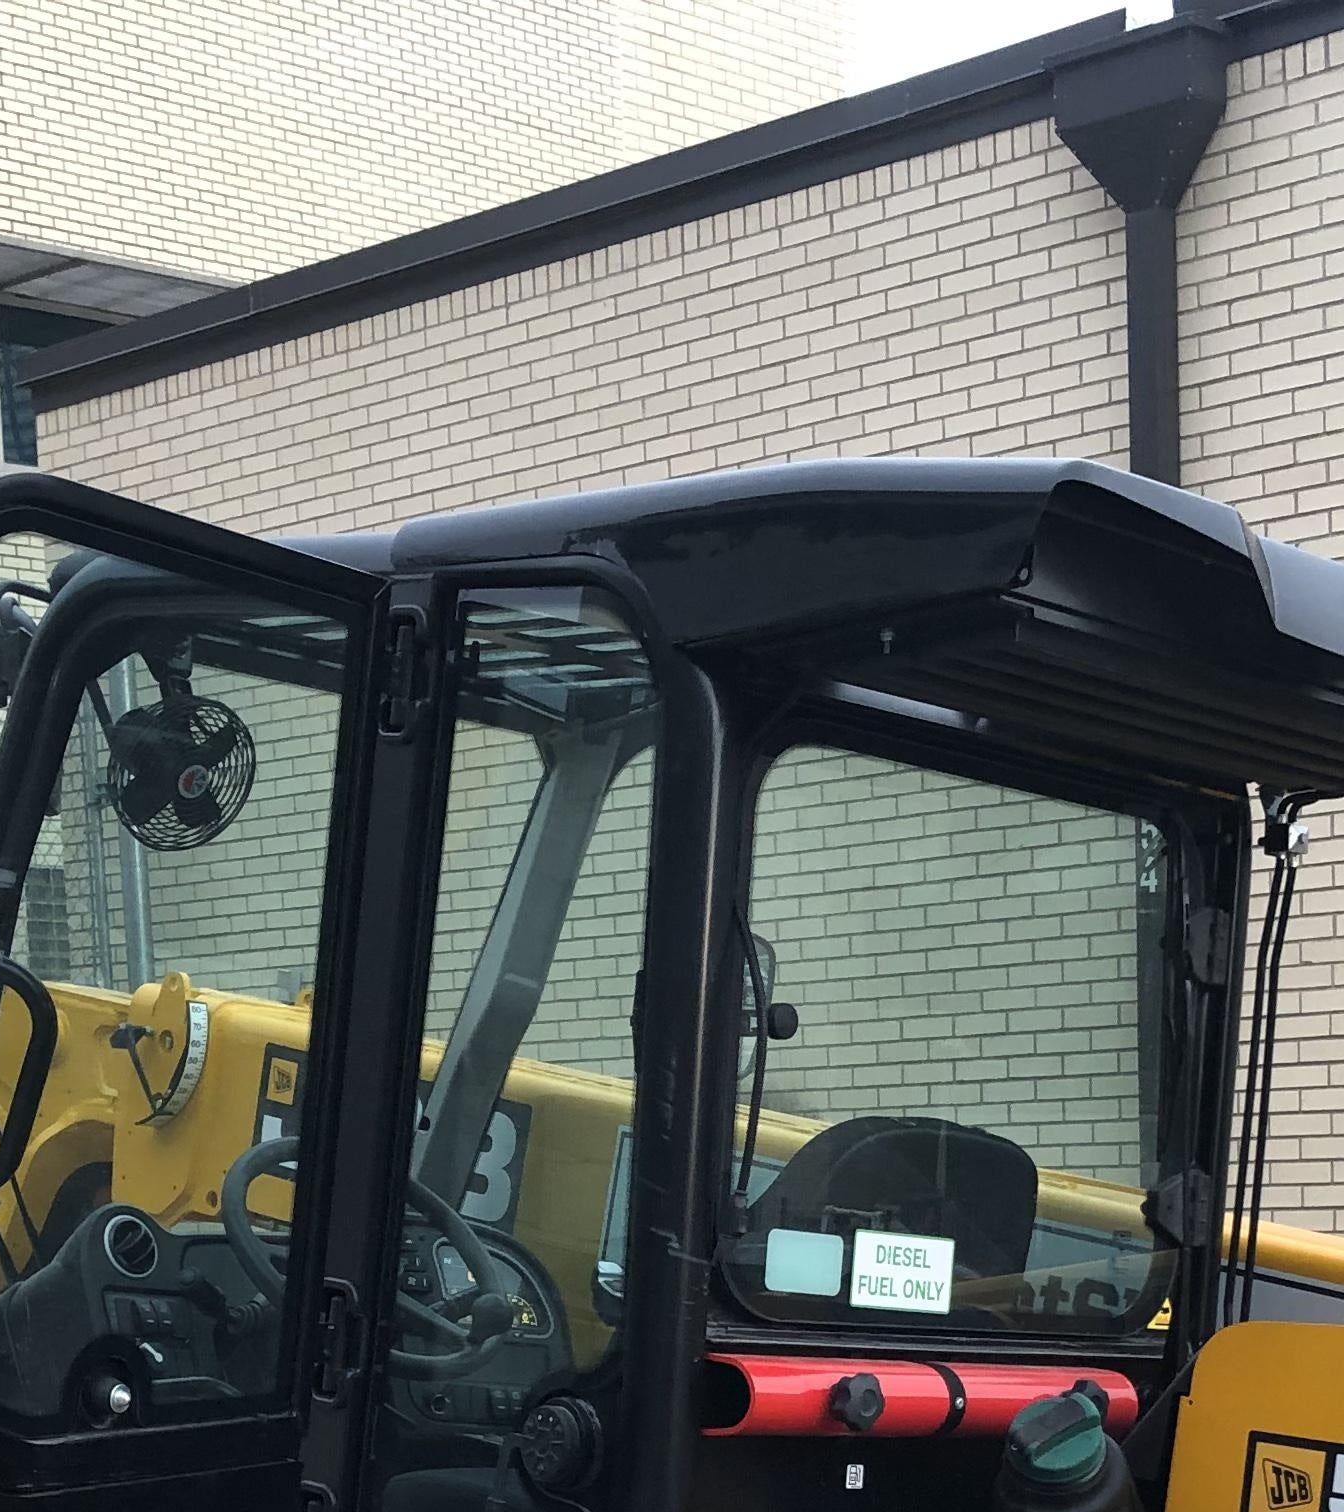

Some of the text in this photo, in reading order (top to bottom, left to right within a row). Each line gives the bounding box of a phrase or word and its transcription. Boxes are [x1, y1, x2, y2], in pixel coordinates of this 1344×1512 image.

[192, 1022, 202, 1031] 70
[190, 1040, 202, 1049] 60
[875, 1244, 932, 1270] DIESEL
[857, 1274, 945, 1302] FUEL ONLY
[1269, 1464, 1309, 1505] JCB
